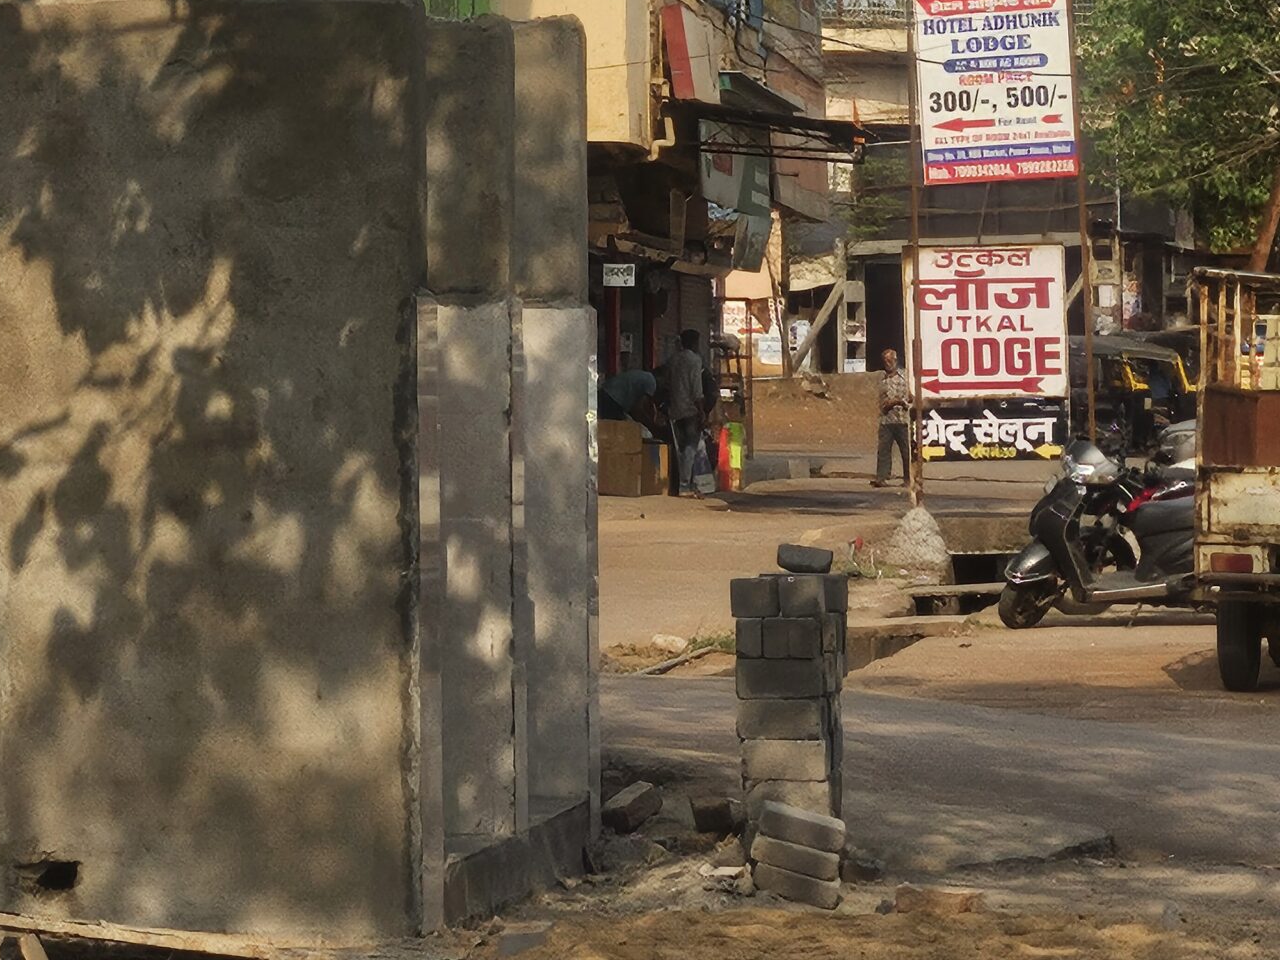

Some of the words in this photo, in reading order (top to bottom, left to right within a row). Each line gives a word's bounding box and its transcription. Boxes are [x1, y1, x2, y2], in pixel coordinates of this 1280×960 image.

[923, 16, 977, 35] HOTEL
[982, 10, 1061, 31] ADHUNIK
[951, 34, 1032, 54] LODGE
[929, 88, 998, 114] 300/-,
[1006, 84, 1068, 109] 500/-
[914, 268, 1056, 310] लॉज
[937, 315, 1034, 333] UTKAL
[972, 409, 1058, 452] सेलून
